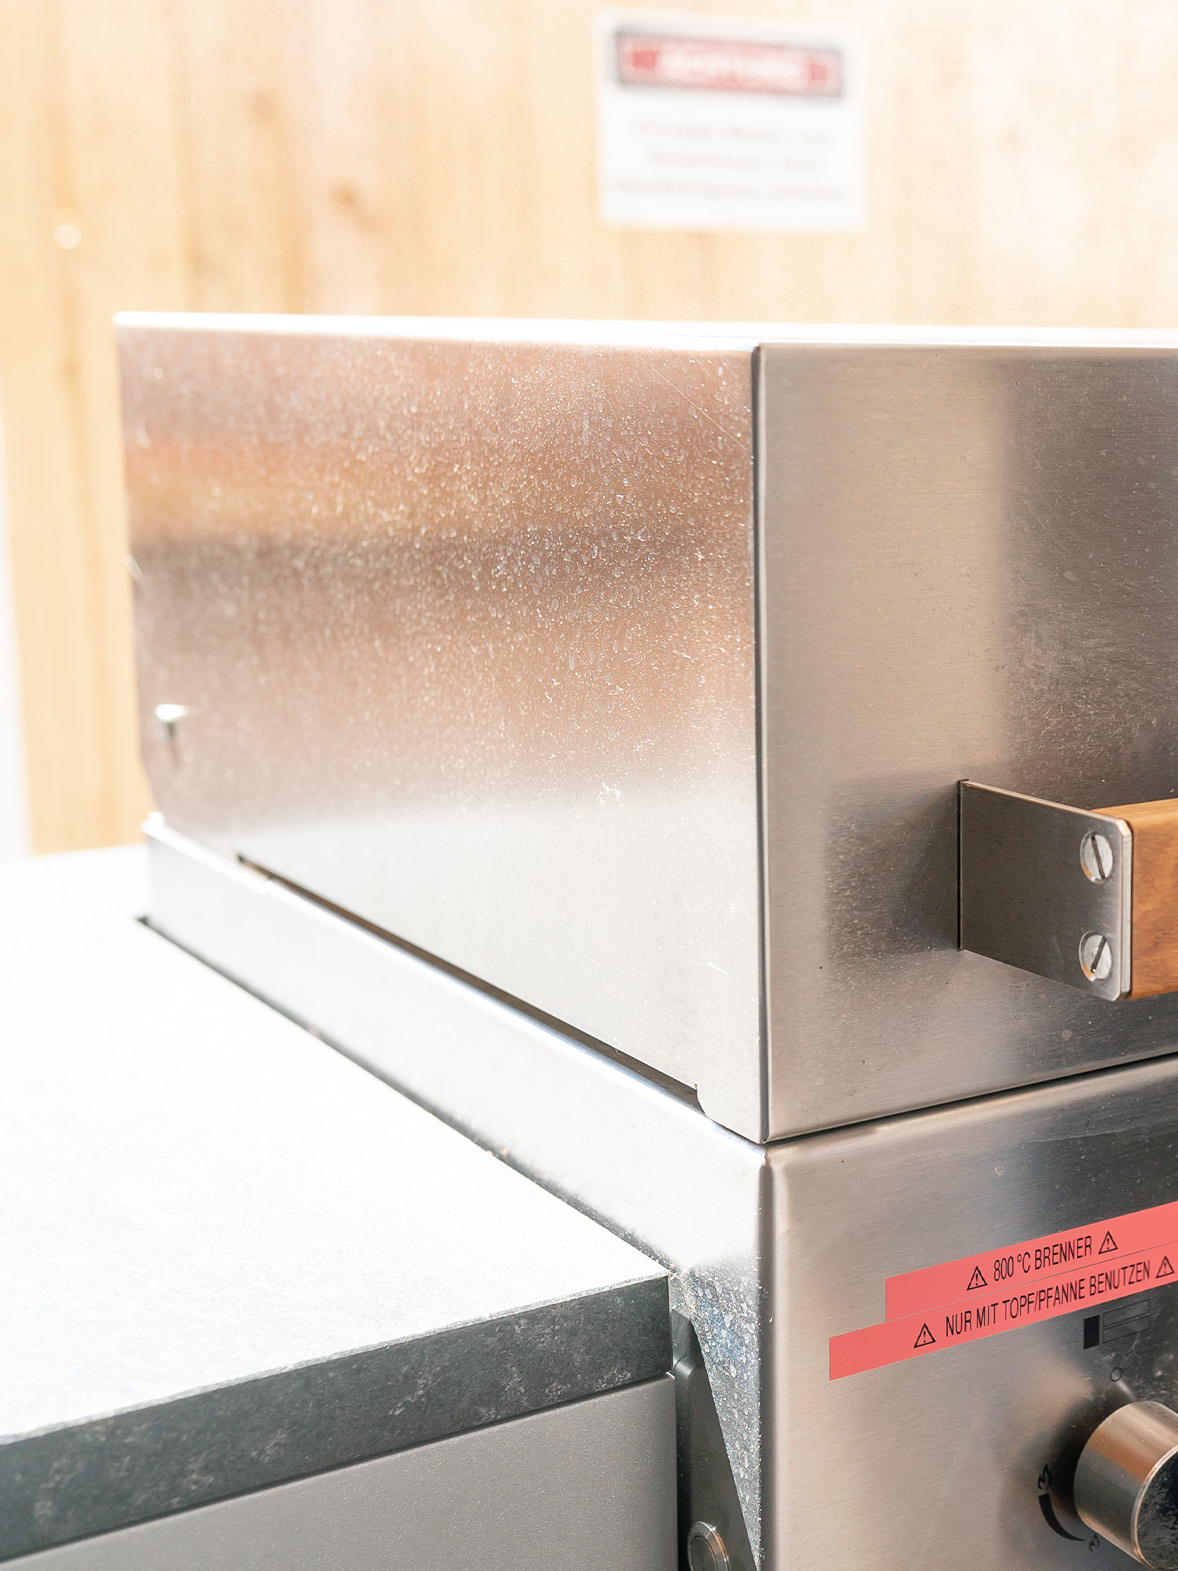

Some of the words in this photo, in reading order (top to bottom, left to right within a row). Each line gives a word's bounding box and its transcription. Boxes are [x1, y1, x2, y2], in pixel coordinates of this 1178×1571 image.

[993, 1256, 1014, 1281] 800
[1017, 1251, 1031, 1273] °C
[1034, 1235, 1093, 1270] BRENNER
[945, 1310, 972, 1337] NUR
[976, 1302, 999, 1329] MIT
[1002, 1278, 1086, 1321] TOPF/PFANNE
[1089, 1259, 1151, 1297] BENUTZEN
